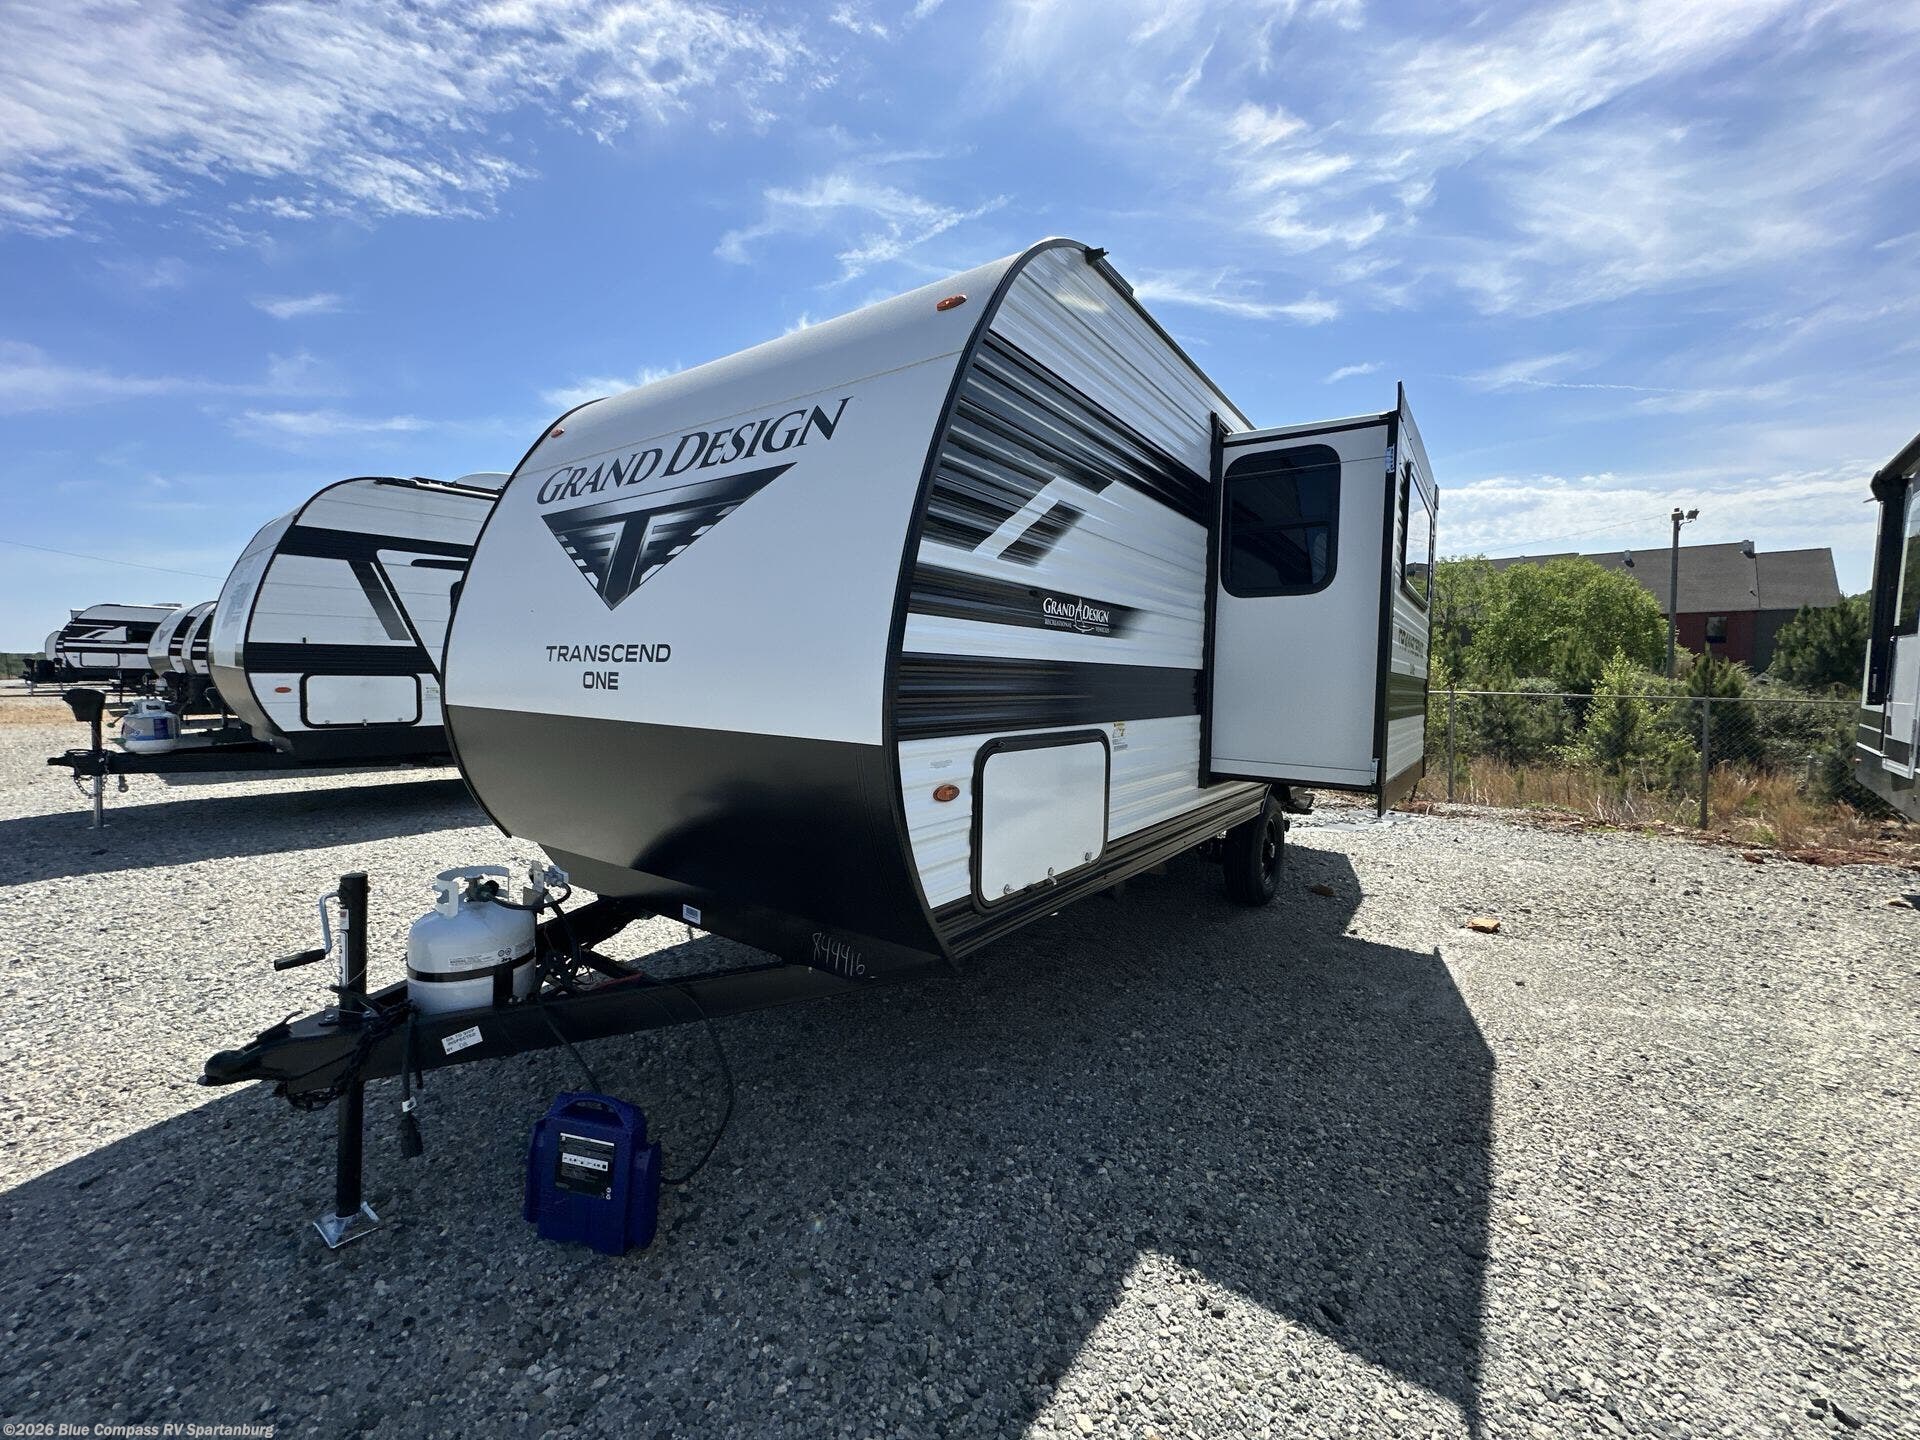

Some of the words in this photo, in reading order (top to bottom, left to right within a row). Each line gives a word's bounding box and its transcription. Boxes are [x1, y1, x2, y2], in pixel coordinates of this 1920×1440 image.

[537, 448, 663, 505] GRAND
[660, 396, 853, 478] DESIGN
[1043, 597, 1075, 617] GRAND
[1083, 605, 1110, 623] DESIGN
[546, 643, 671, 663] TRANSCEND
[582, 671, 619, 690] ONE
